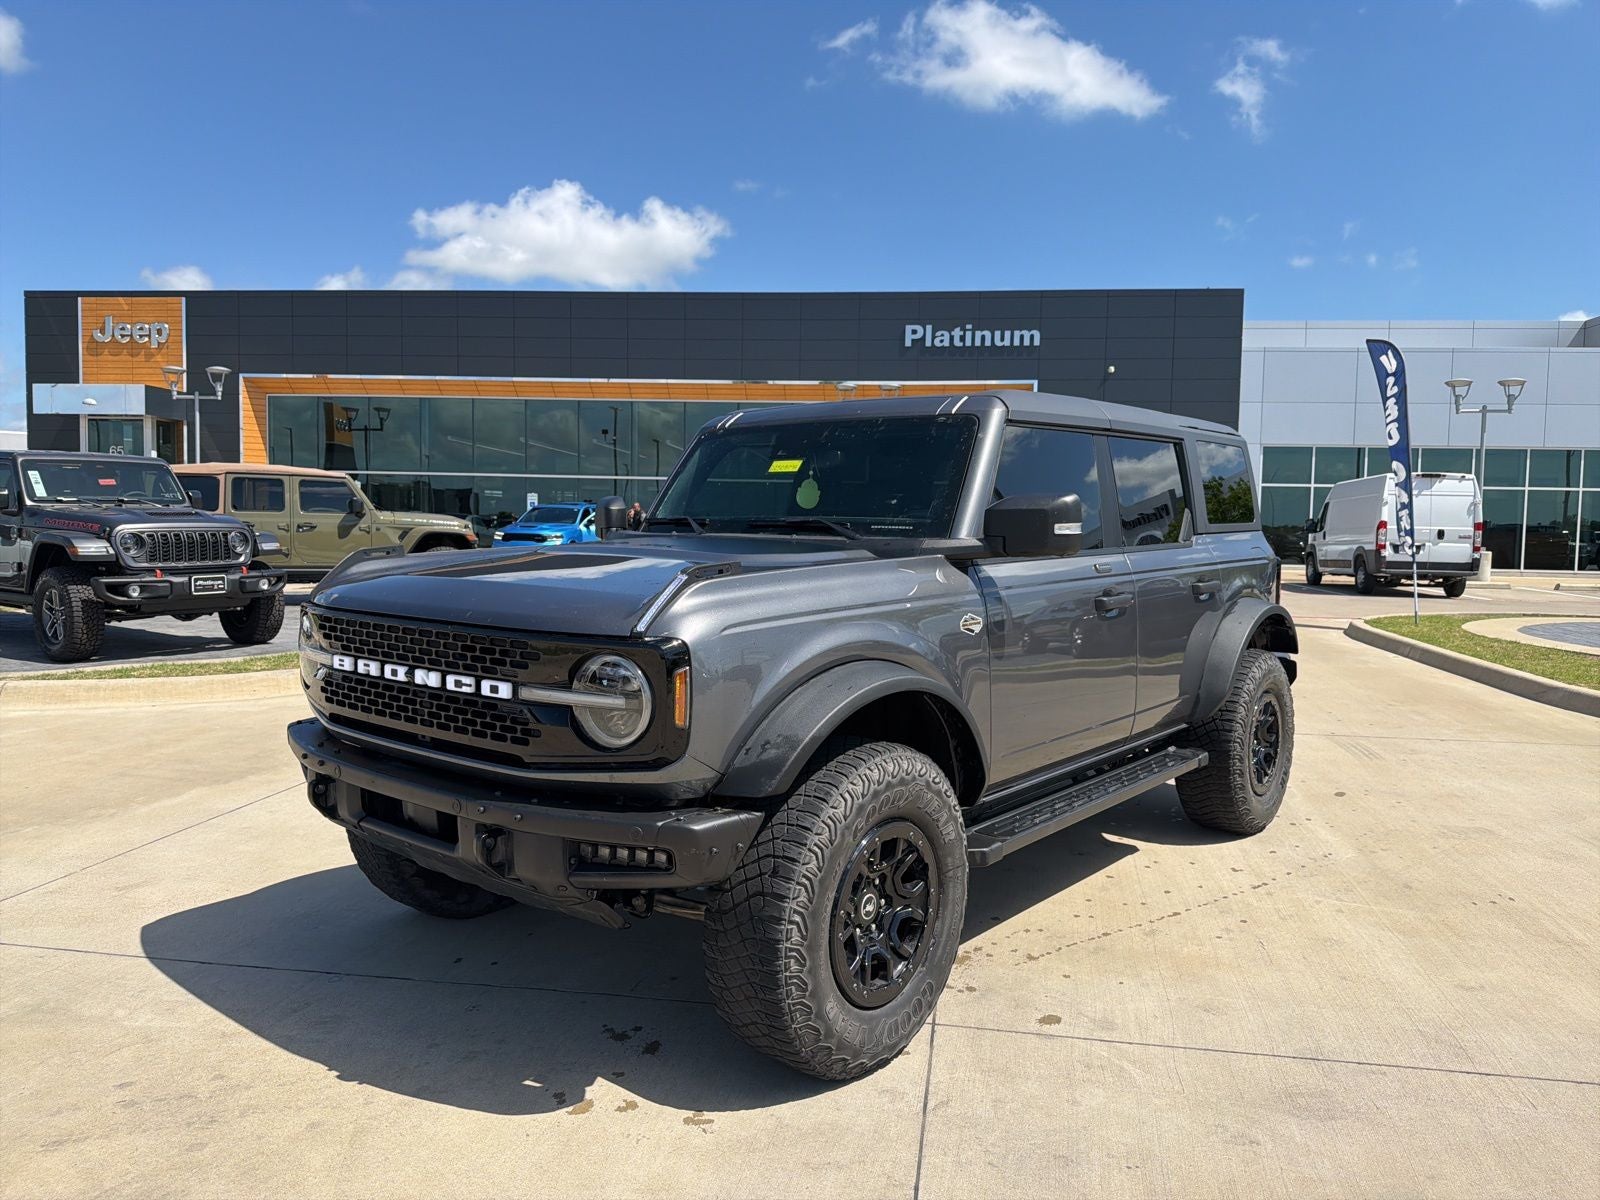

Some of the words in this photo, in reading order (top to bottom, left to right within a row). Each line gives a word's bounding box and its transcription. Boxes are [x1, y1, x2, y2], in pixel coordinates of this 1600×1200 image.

[92, 315, 169, 348] Jeep
[904, 324, 1041, 347] Platinum
[109, 445, 124, 456] 65
[44, 517, 101, 531] MOJAVE
[333, 654, 513, 700] BRONCO
[853, 783, 956, 844] GOODYEAR
